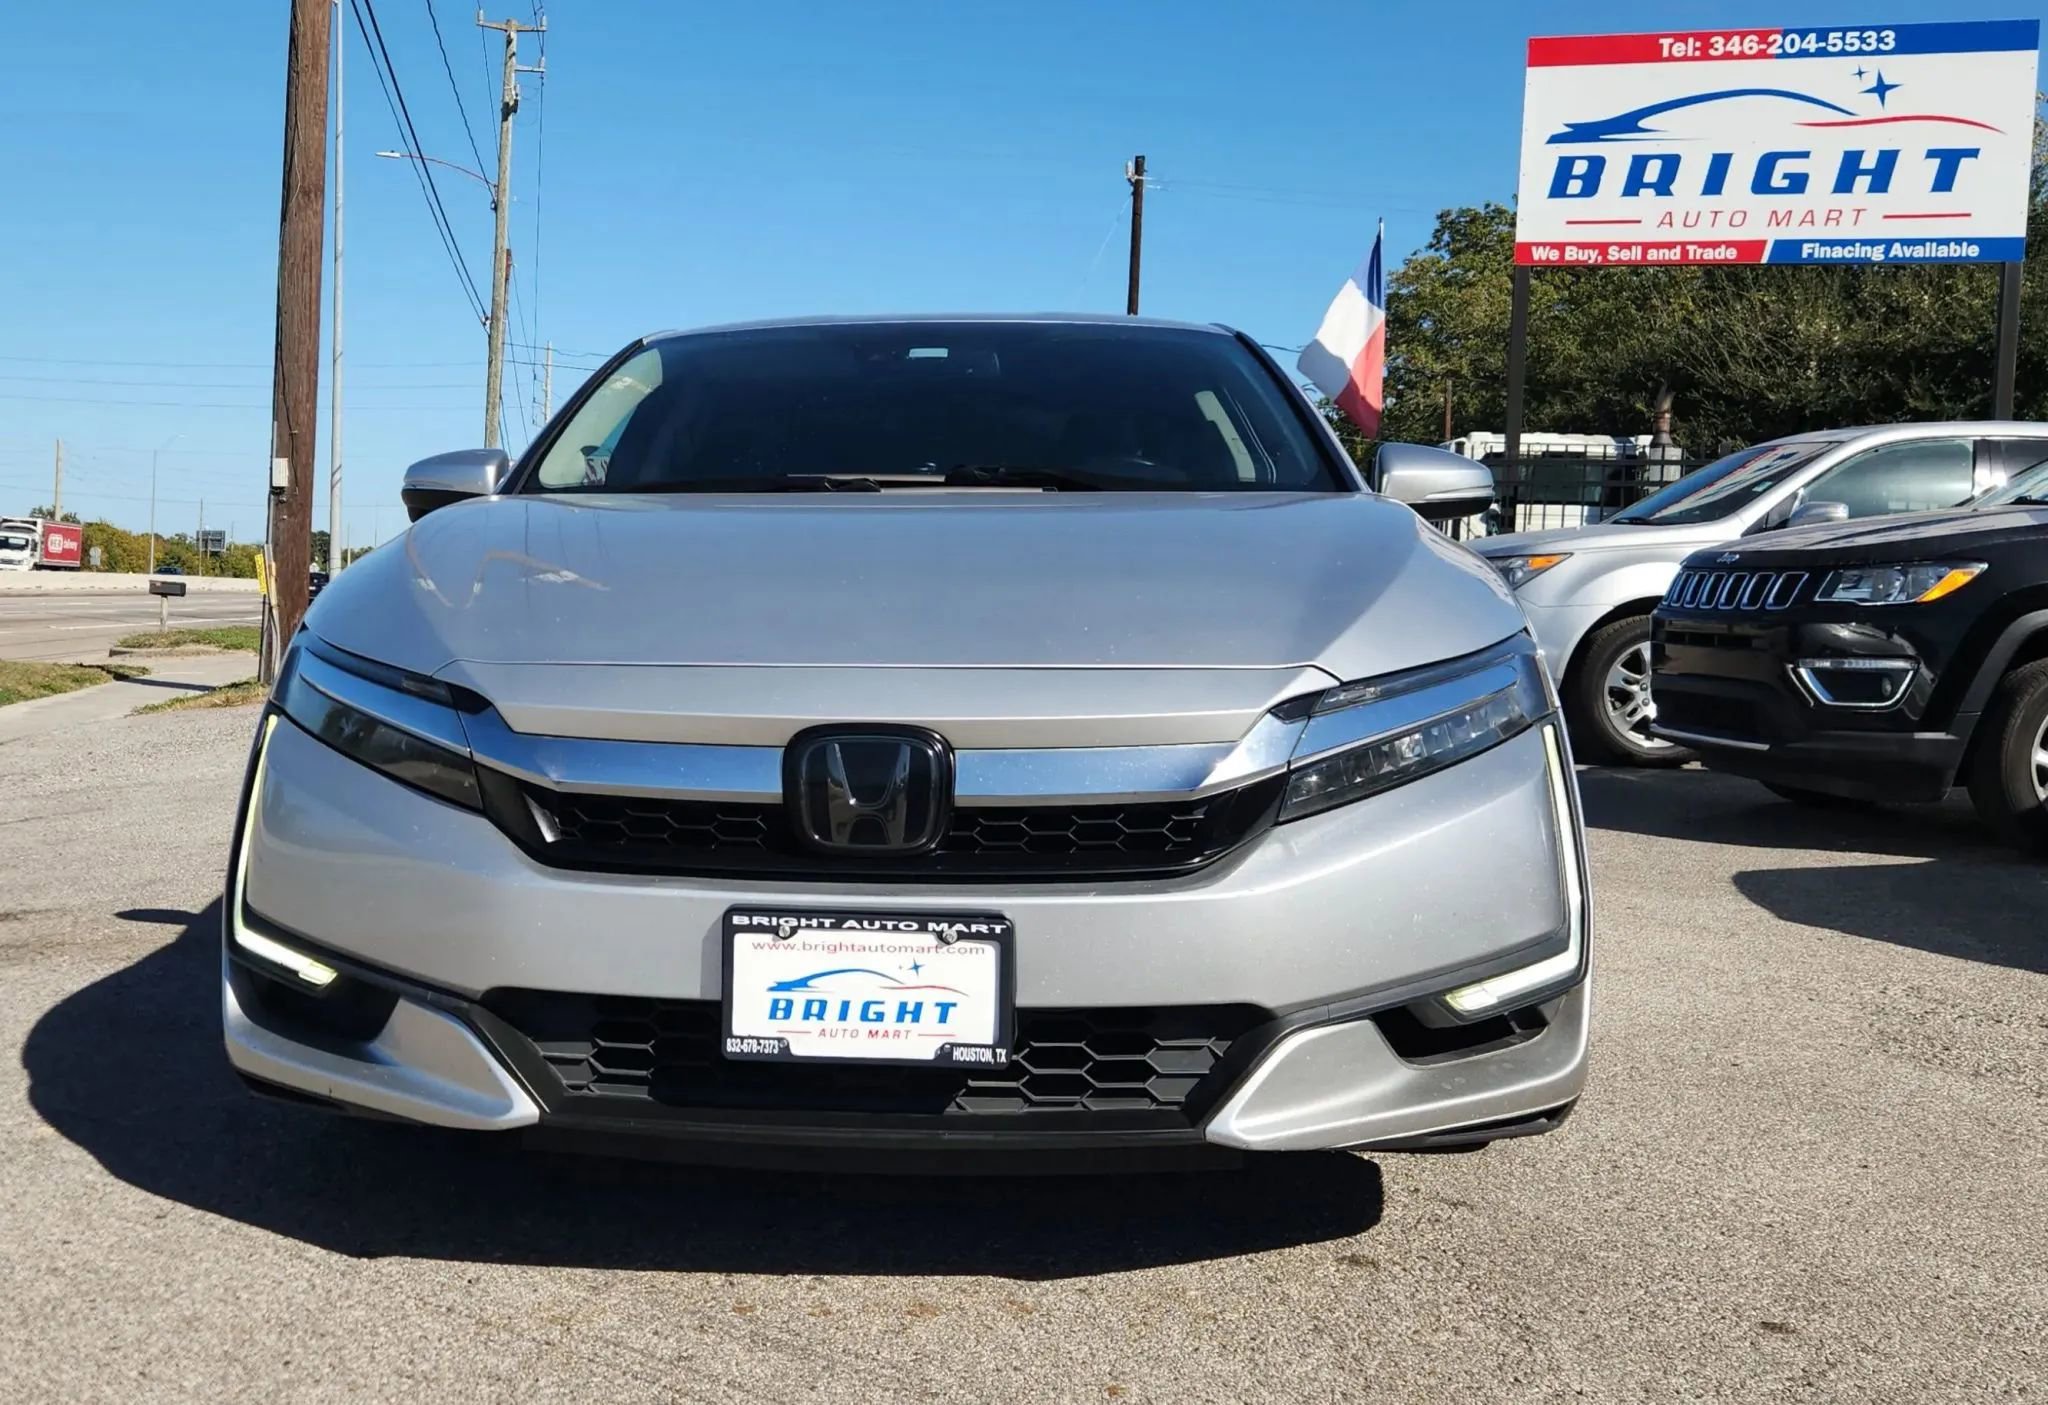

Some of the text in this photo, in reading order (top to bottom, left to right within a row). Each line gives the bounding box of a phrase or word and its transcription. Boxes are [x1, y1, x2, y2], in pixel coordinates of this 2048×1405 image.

[1658, 29, 1897, 58] Tel: 346-204-5533
[1546, 147, 1981, 199] BRIGHT
[1656, 208, 1869, 229] AUTO MART
[1531, 244, 1737, 263] We Buy, Sell and Trade
[1801, 241, 1980, 261] Finacing Available
[732, 915, 1007, 934] BRIGHT AUTO MART
[751, 940, 986, 955] www.brightautomart.com
[768, 997, 958, 1024] BRIGHT
[817, 1028, 913, 1040] AUTO MART
[952, 1046, 1007, 1064] HOUSTON, TX
